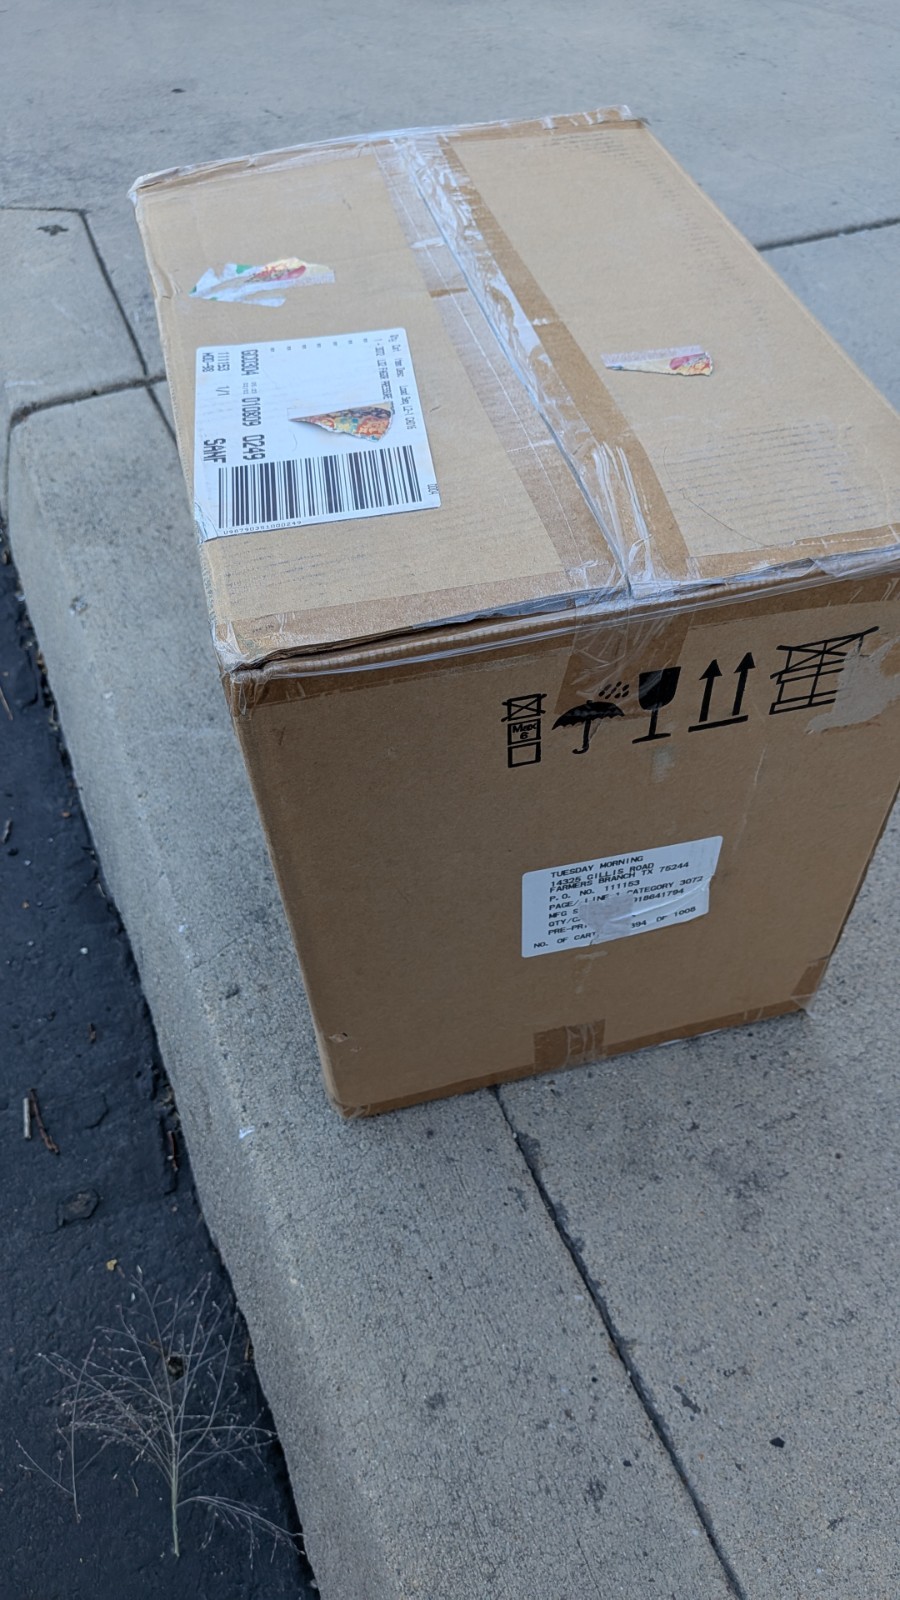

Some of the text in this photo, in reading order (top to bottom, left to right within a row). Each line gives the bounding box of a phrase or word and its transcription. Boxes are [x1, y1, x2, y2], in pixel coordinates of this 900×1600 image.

[203, 438, 227, 463] SANF
[242, 434, 265, 461] 0249
[549, 861, 689, 893] FARMERS BRANCH TX 75244
[551, 855, 644, 878] TUESDAY MORNING
[551, 862, 654, 887] 14325 GILLIS ROAD
[579, 888, 595, 897] NO.
[605, 880, 640, 891] 111153
[679, 876, 704, 886] 3072
[548, 910, 568, 919] MFG
[533, 941, 549, 949] NO.
[556, 936, 569, 944] OF
